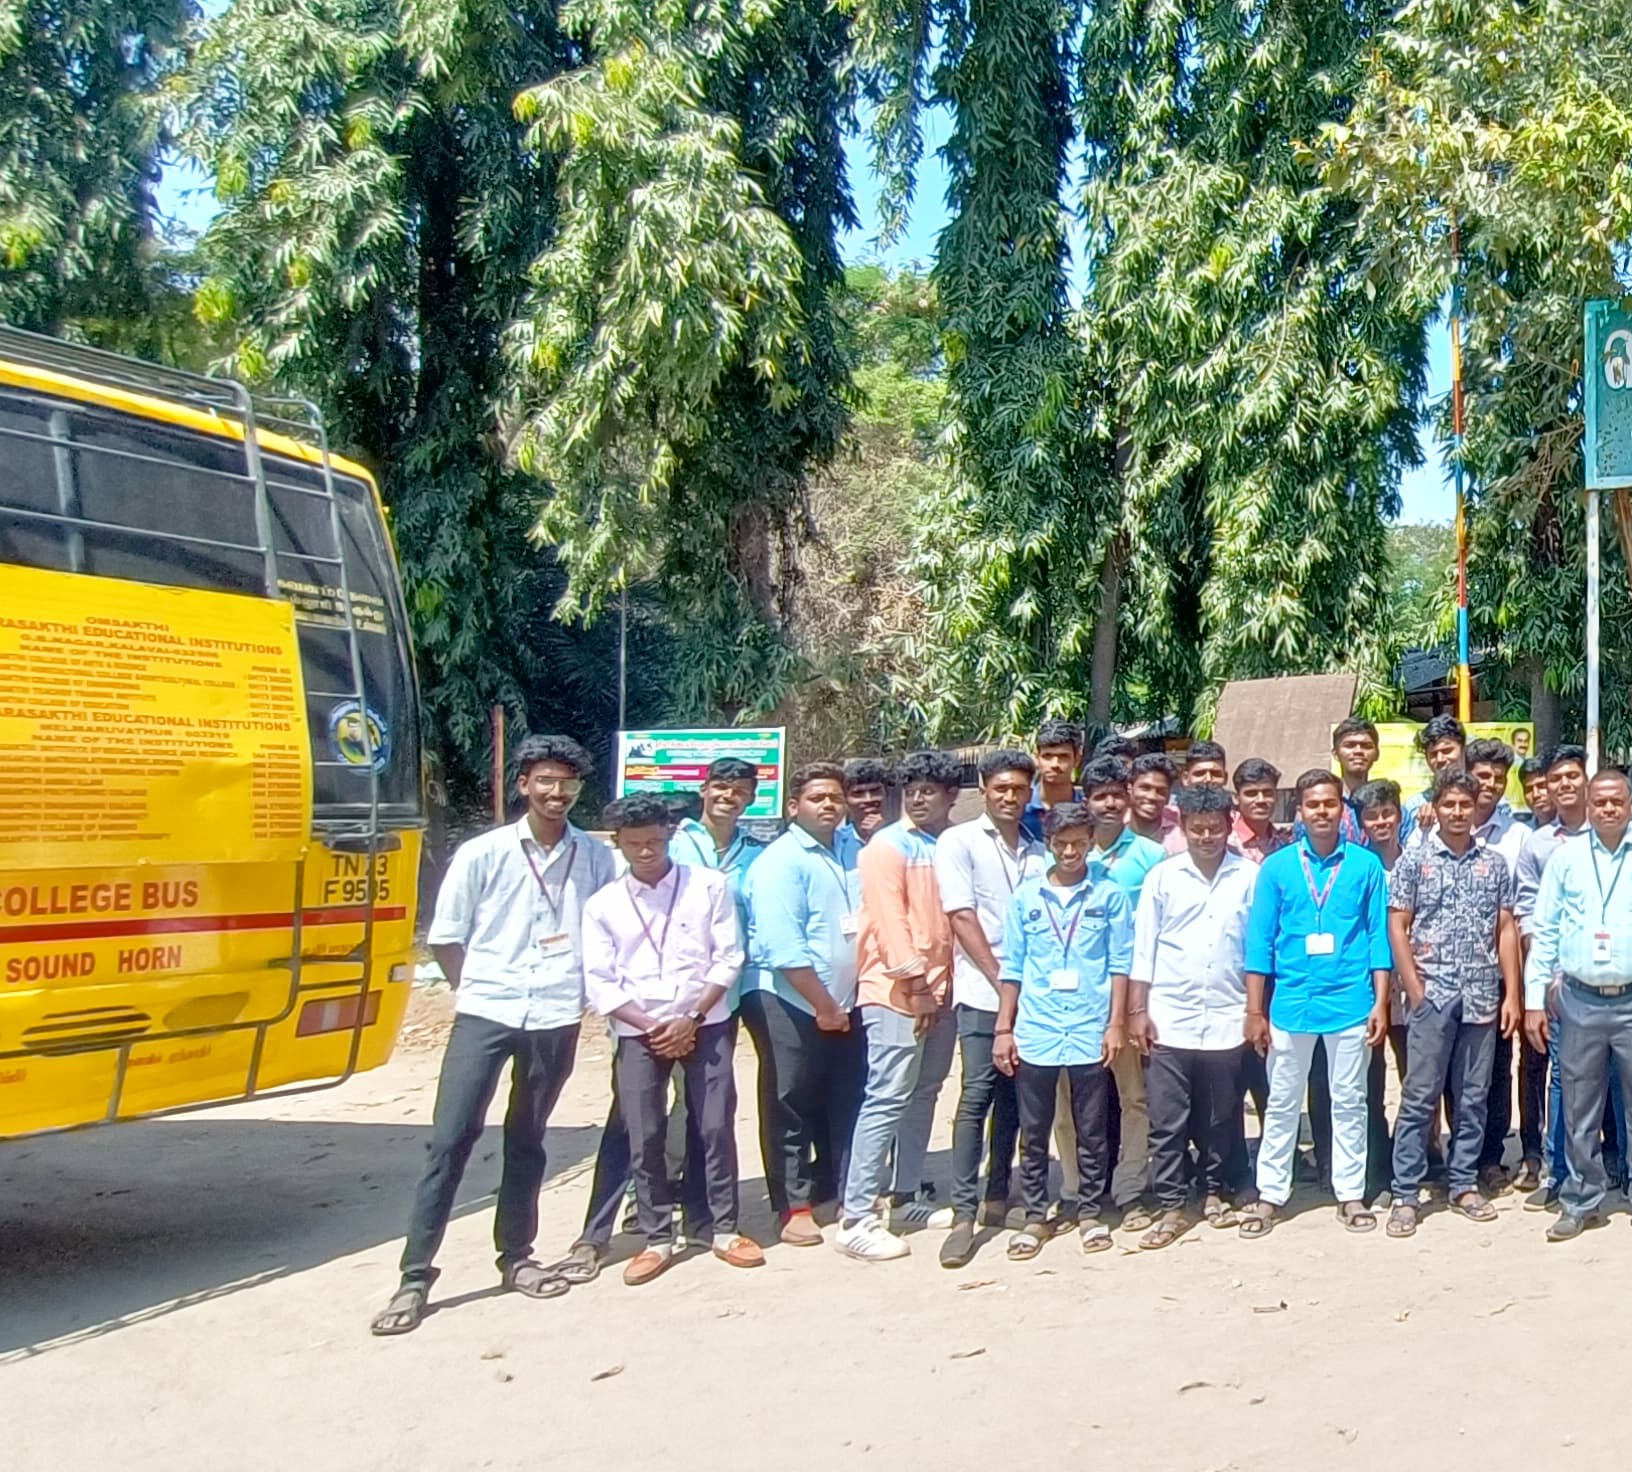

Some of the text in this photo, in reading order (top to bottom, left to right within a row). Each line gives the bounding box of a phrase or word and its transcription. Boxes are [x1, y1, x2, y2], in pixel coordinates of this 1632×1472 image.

[85, 616, 169, 632] OMSAKTHI
[83, 626, 184, 646] EDUCATIONAL
[189, 637, 283, 656] INSTITUTIONS
[126, 654, 223, 668] INSTITUTIONS
[92, 711, 194, 728] EDUCATIONAL
[199, 718, 292, 731] INSTITUTIONS
[139, 739, 233, 749] INSTITUTIONS
[331, 853, 388, 877] TN 3
[0, 881, 198, 916] OLLEGE BUS
[323, 878, 389, 904] F 955
[6, 945, 182, 983] SOUND HORN
